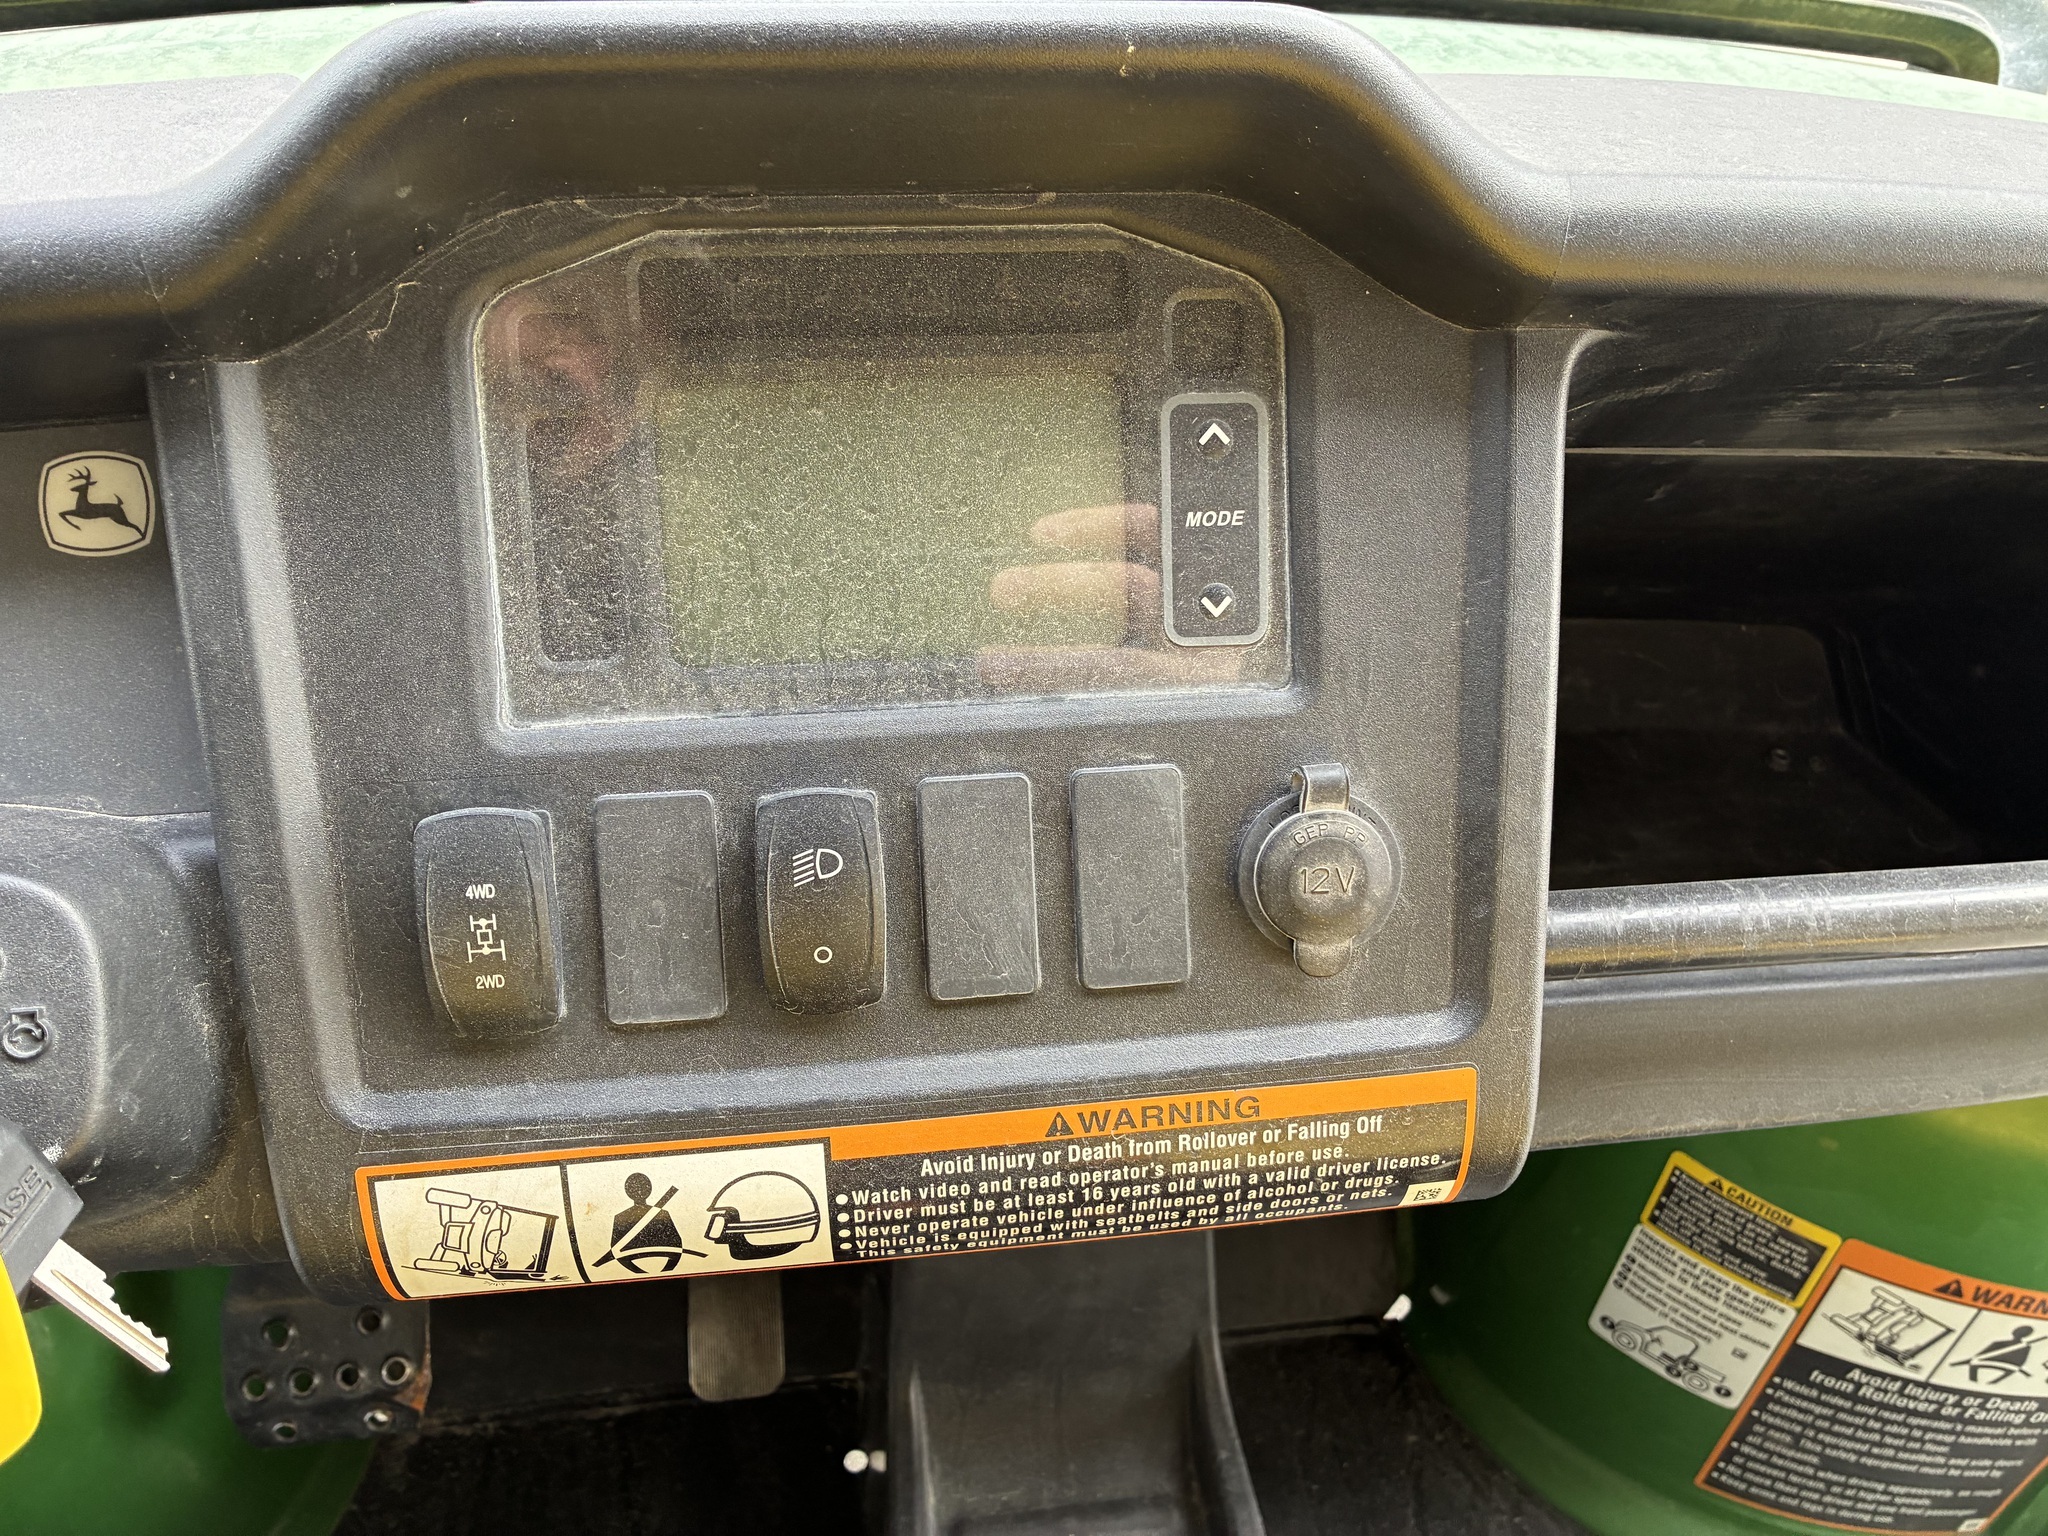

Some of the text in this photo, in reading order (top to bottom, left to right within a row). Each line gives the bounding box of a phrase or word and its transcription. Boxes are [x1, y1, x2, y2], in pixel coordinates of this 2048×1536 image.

[1185, 510, 1245, 527] MODE
[465, 884, 495, 899] 4WD
[1300, 866, 1355, 895] 12V
[475, 974, 505, 989] 2WD
[1077, 1096, 1260, 1133] WARNING
[921, 1115, 1383, 1177] Avoid Injury or Death from Rollover or Falling Off
[852, 1146, 1349, 1205] Watch video and read operator's manual before use.
[854, 1153, 1446, 1223] Driver must be at least 16 years old with a valid driver license.
[855, 1173, 1399, 1237] Never operate vehicle under influence of alcohol or drugs.
[855, 1188, 1392, 1249] Vehicle is equipped with seatbelts and side doors or nets.
[1726, 1186, 1794, 1226] CAUTION
[857, 1203, 1348, 1258] This safety equipment must be used by all occupants.
[1846, 1367, 2039, 1412] Avoid Injury or Death
